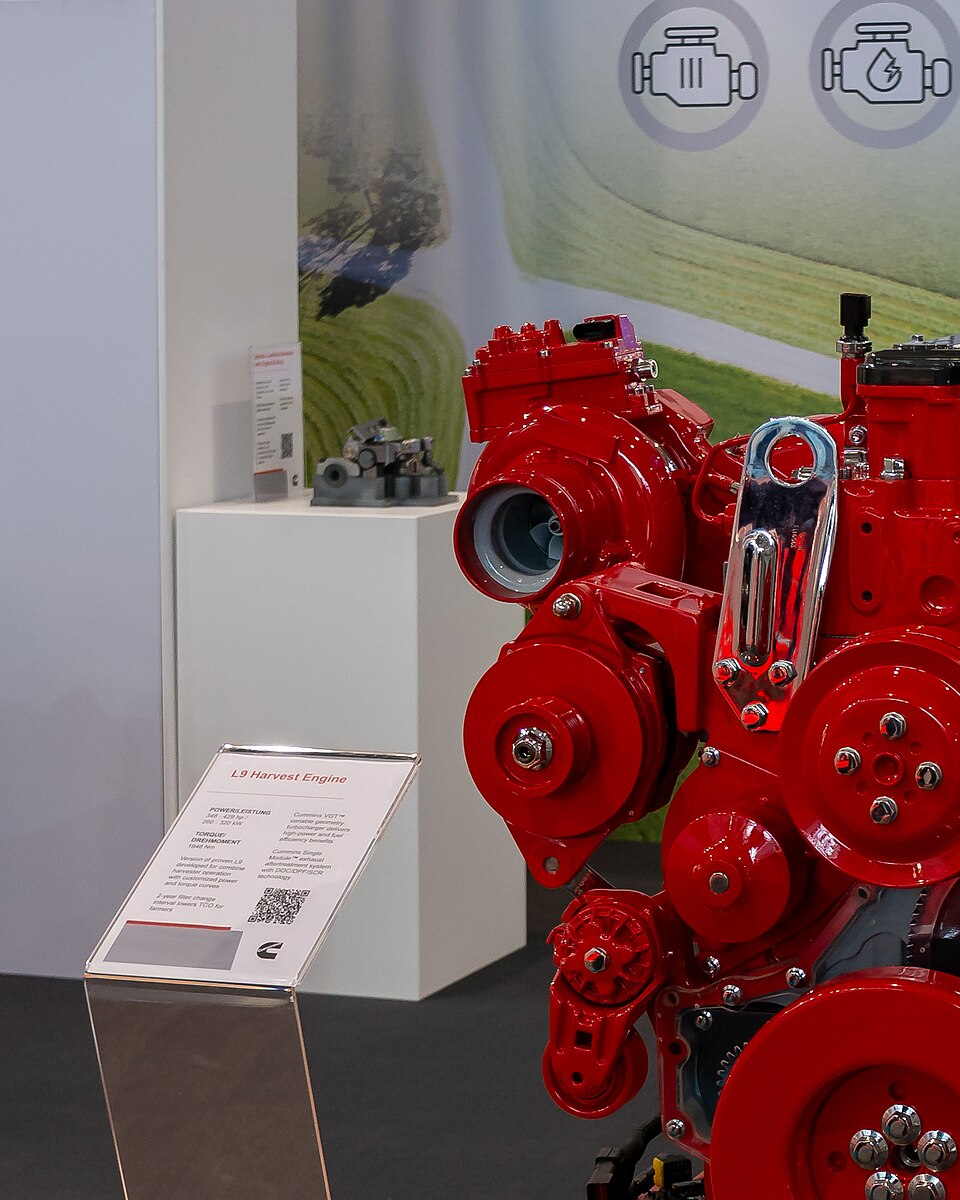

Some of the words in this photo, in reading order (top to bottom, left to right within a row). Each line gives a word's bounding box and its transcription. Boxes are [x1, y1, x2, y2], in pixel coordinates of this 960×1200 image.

[231, 769, 249, 779] L9
[250, 770, 301, 782] Harvest
[302, 772, 348, 785] Engine
[209, 807, 272, 816] POWER/LEISTUNG
[190, 837, 242, 845] DREHMOMENT
[278, 836, 309, 844] efficiency
[302, 849, 323, 857] Single
[256, 873, 292, 881] technology
